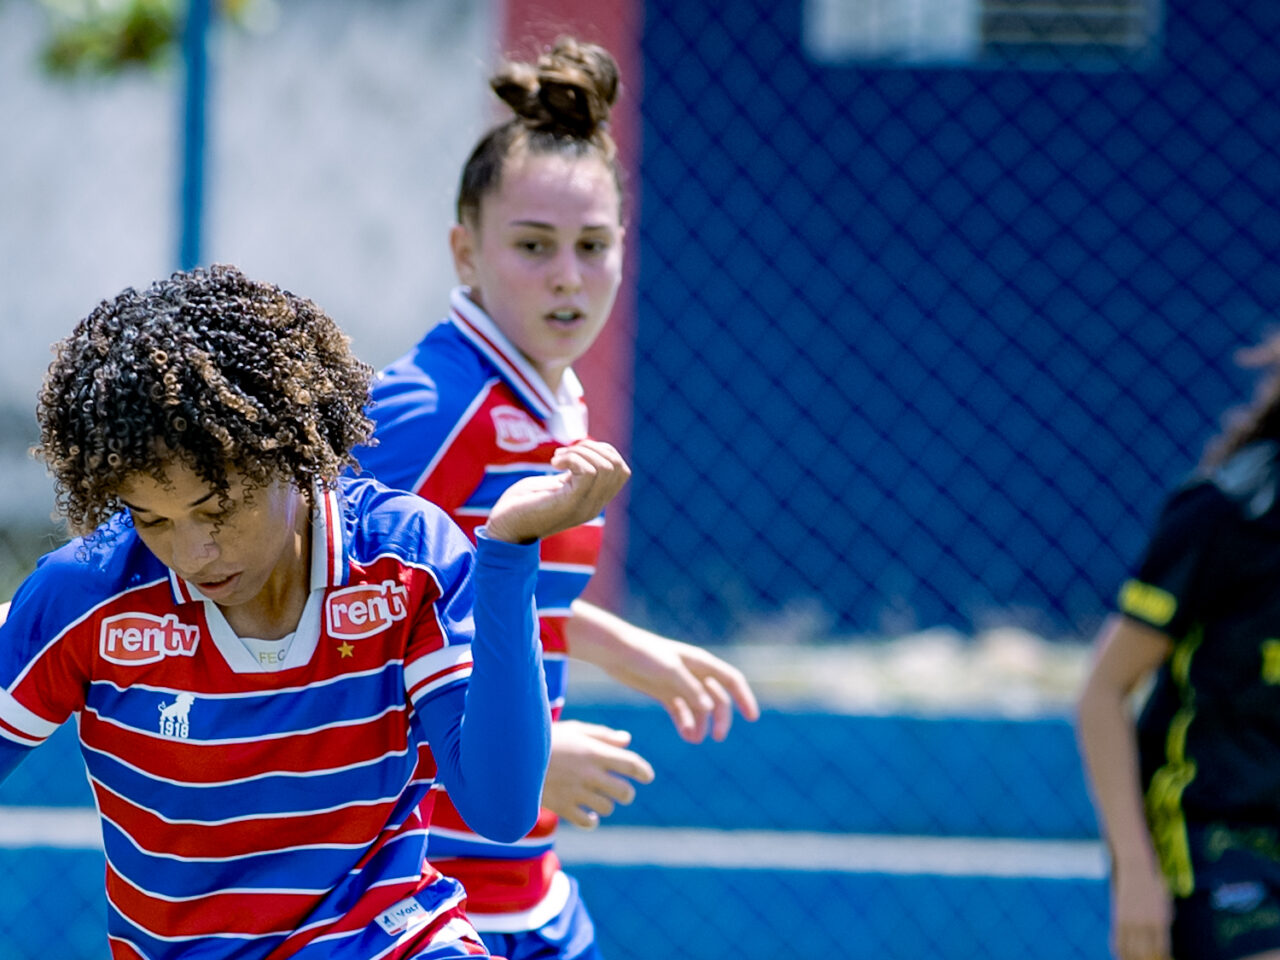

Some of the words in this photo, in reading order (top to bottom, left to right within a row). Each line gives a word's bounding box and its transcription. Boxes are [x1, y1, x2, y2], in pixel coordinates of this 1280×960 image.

[105, 617, 198, 653] rentv
[258, 649, 287, 664] FEC
[158, 720, 190, 738] 1918
